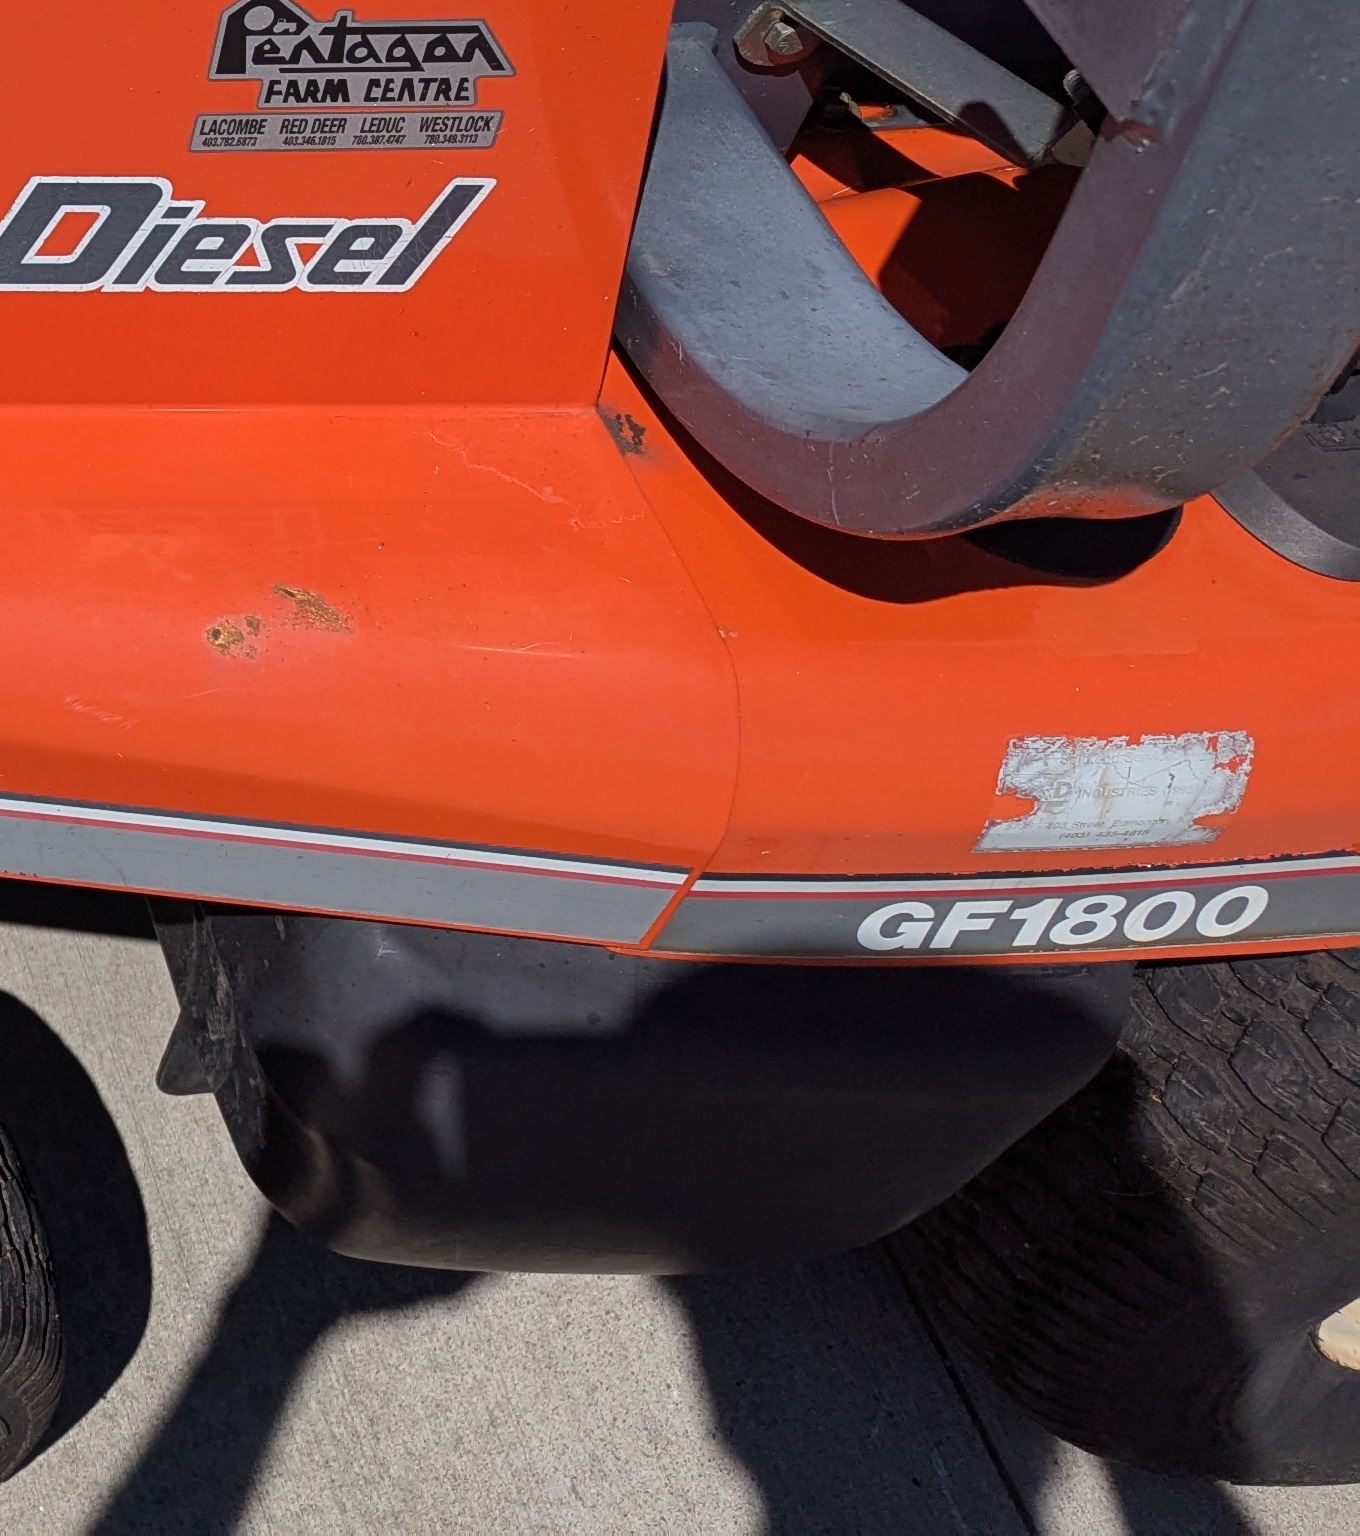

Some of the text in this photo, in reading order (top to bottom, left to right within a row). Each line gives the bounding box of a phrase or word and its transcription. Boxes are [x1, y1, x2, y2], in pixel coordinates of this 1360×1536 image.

[264, 77, 470, 104] FARM CENTRE
[199, 116, 495, 136] LACOMBE RED DEER LEDUC WESTLOCK
[855, 884, 1270, 951] GF1800
